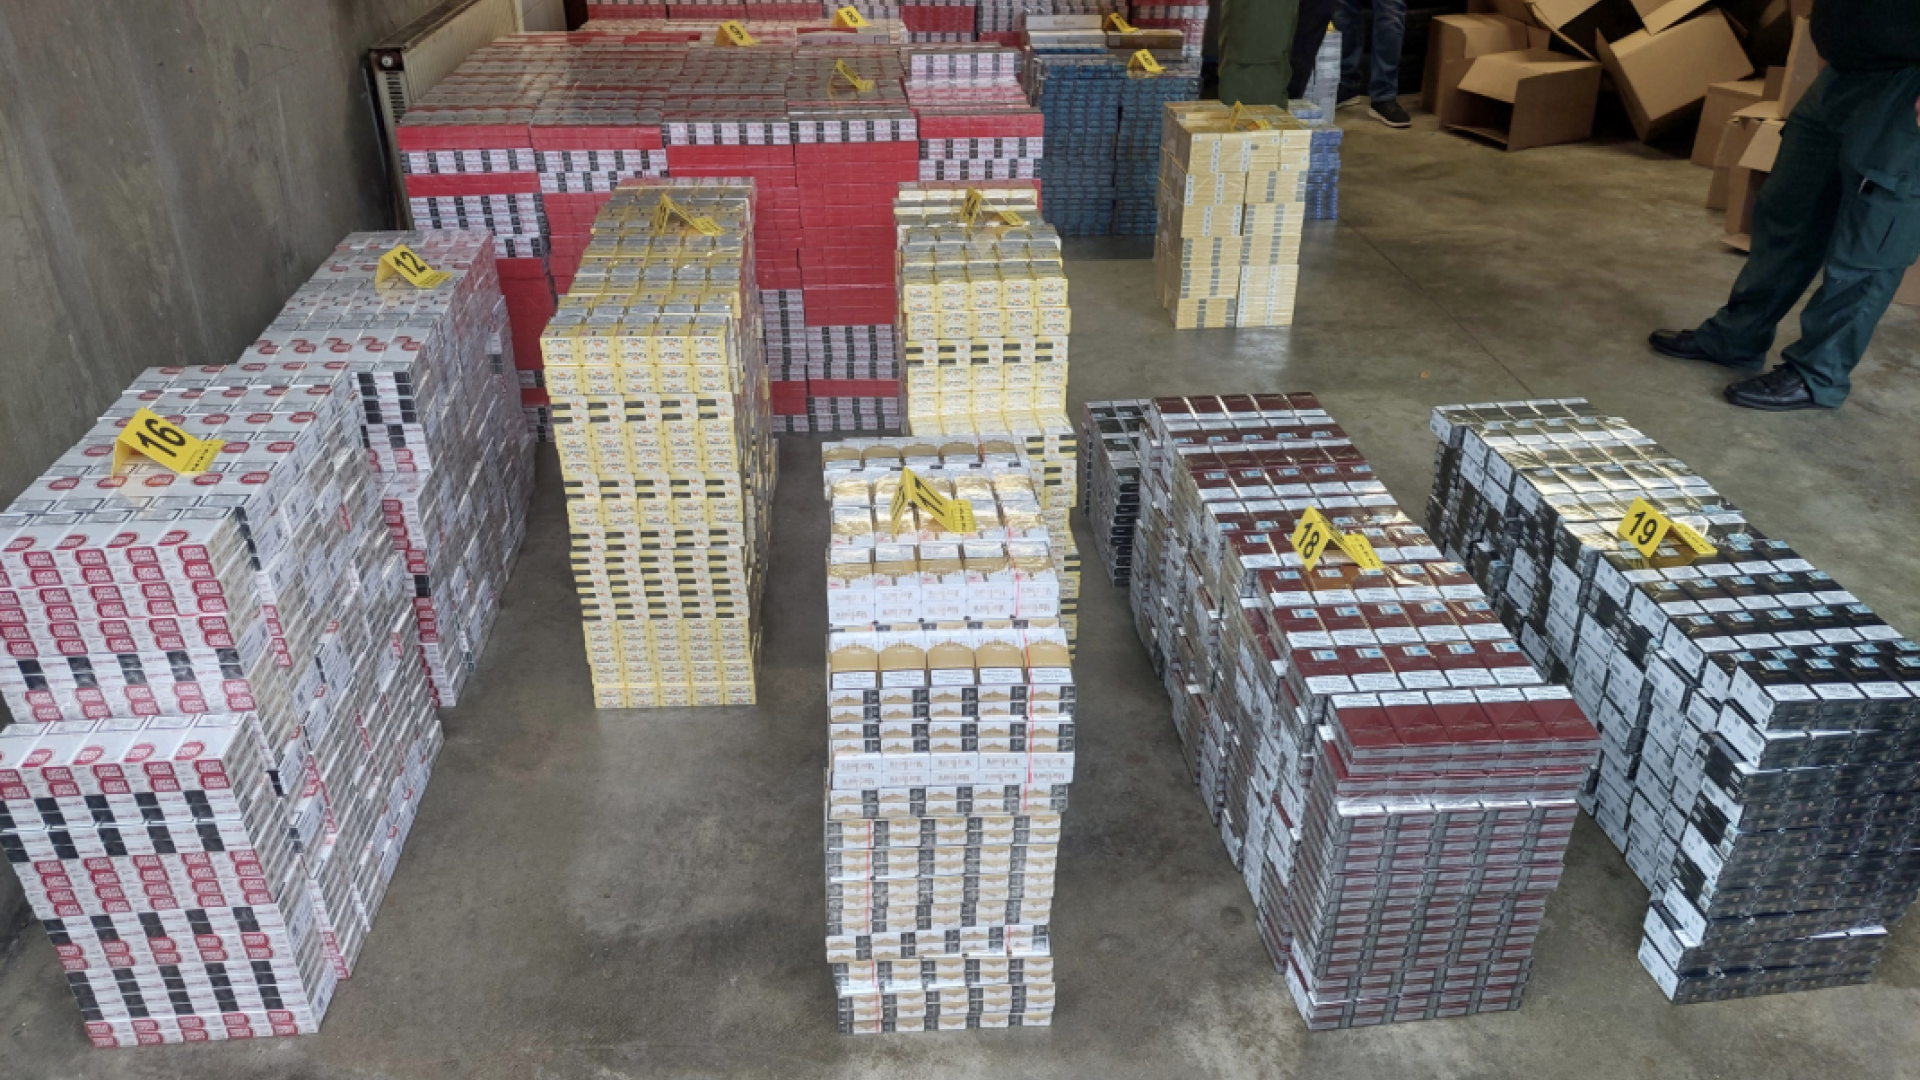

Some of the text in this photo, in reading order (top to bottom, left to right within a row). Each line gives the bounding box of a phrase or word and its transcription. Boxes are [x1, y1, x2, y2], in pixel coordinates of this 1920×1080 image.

[393, 251, 426, 277] 12
[136, 418, 186, 458] 16
[1298, 522, 1320, 559] 18
[1629, 510, 1658, 545] 19
